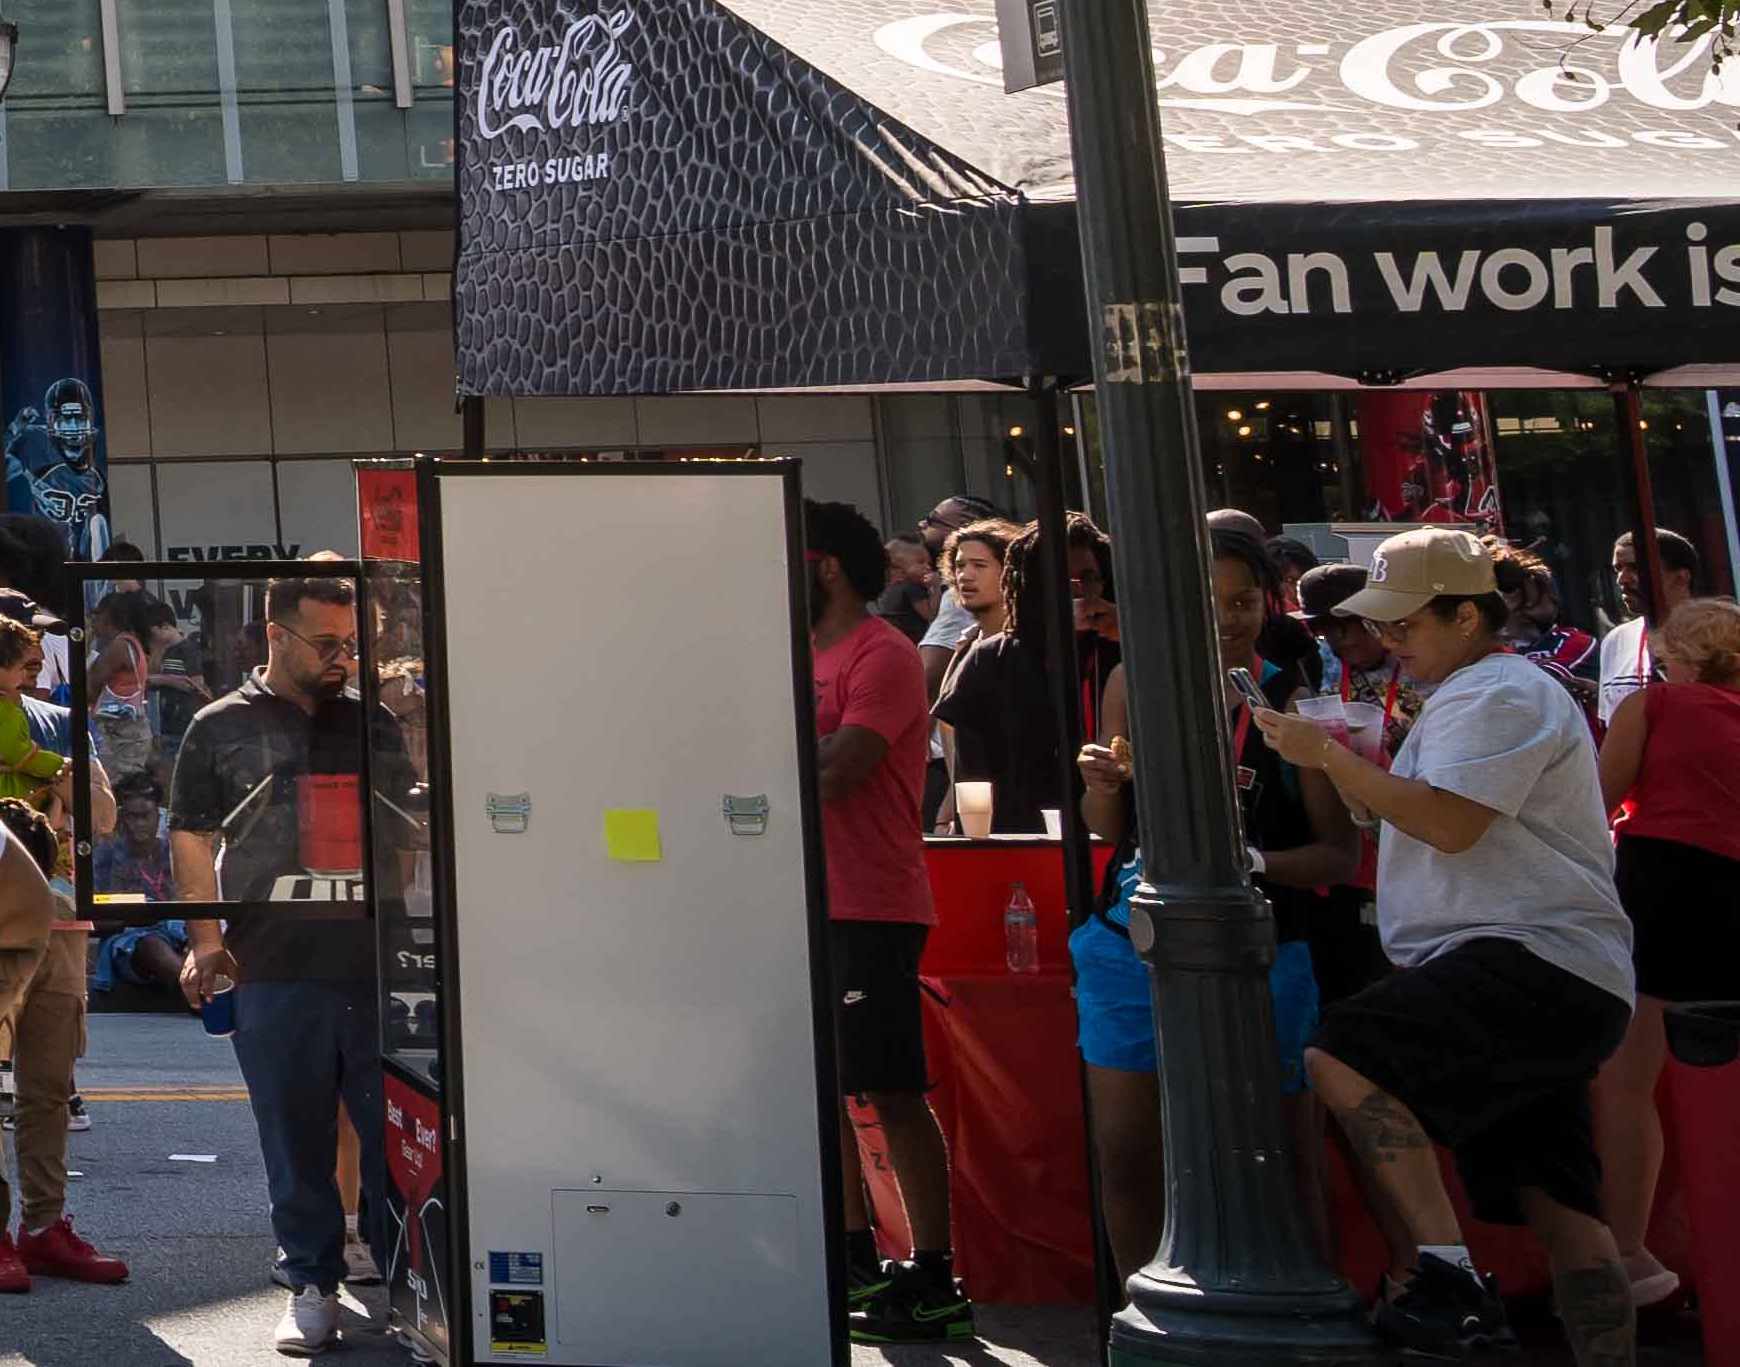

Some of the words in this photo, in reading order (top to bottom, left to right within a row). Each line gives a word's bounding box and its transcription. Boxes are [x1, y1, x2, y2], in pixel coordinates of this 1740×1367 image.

[478, 10, 636, 139] Coca-Cola
[874, 13, 1740, 116] Ca-Col
[493, 161, 540, 191] ZERO
[544, 153, 609, 184] SUGAR
[1164, 132, 1420, 153] ERO
[1177, 236, 1352, 316] Fan
[1374, 226, 1676, 314] work
[1687, 223, 1740, 308] is
